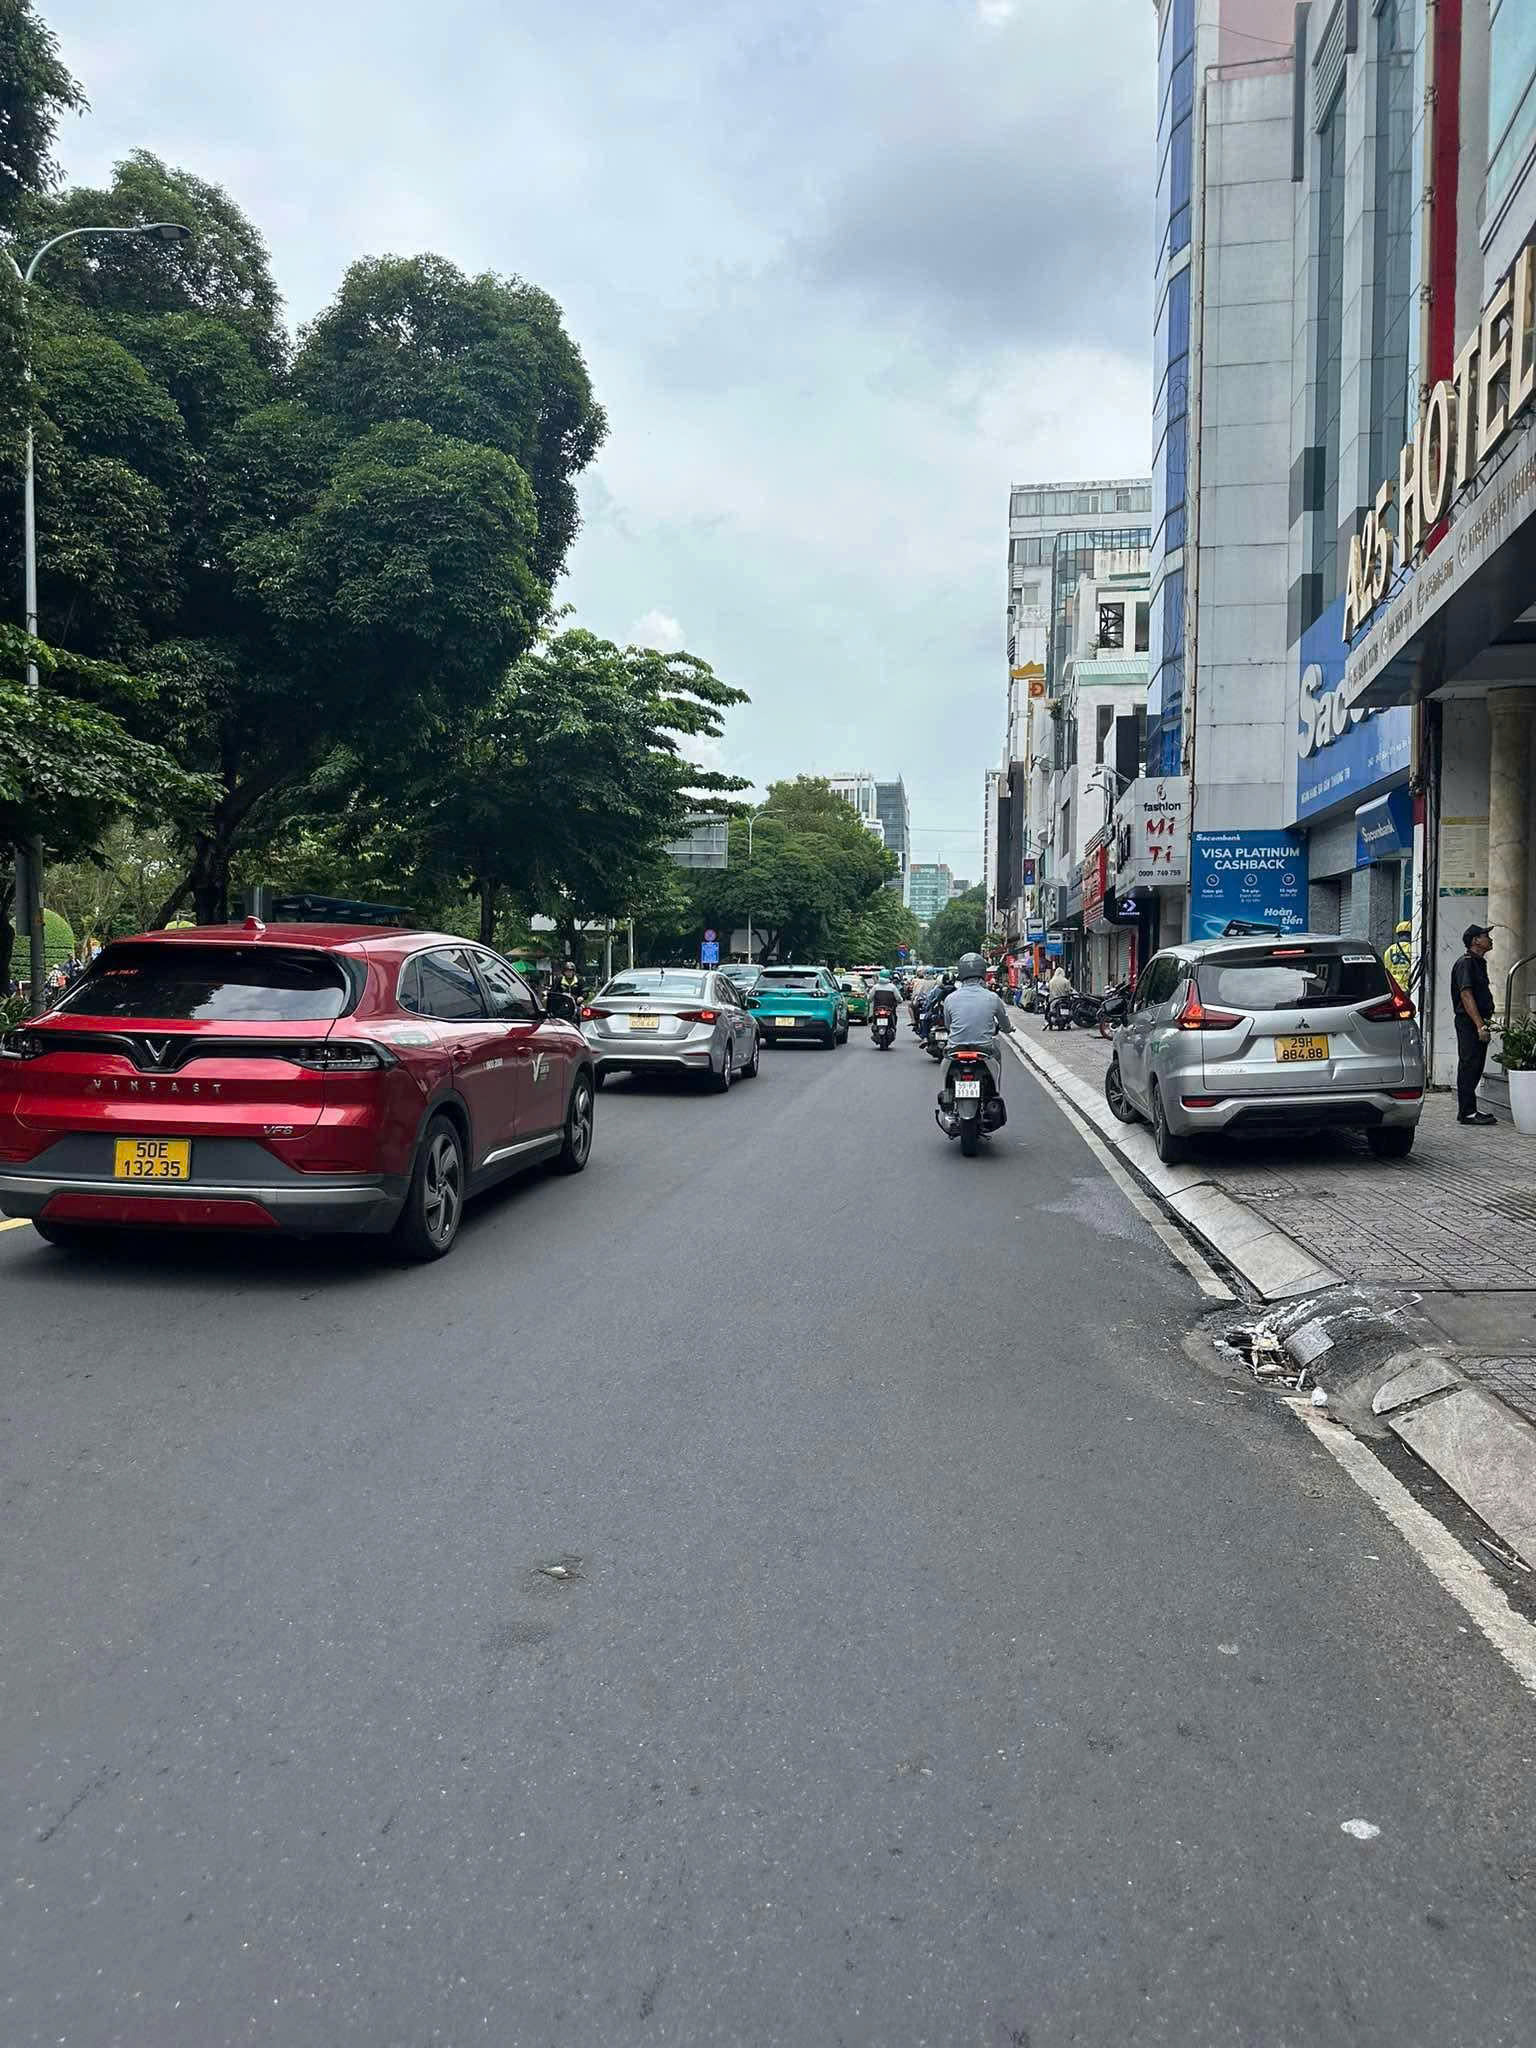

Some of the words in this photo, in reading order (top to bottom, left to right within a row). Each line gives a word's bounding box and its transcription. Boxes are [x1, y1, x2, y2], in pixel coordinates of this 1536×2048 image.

[1342, 479, 1395, 643] A25
[1399, 243, 1536, 568] HOTEL
[1143, 802, 1181, 813] fashion
[1361, 818, 1395, 844] Sacombank
[1195, 834, 1241, 842] Sacombank
[1201, 848, 1232, 858] VISA
[1235, 847, 1300, 858] PLATINUM
[1214, 859, 1286, 870] CASHBACK
[1264, 907, 1293, 917] Hoàn
[1291, 1037, 1313, 1048] 29H
[1282, 1048, 1323, 1060] 884.88
[93, 1078, 223, 1094] VINFAST
[135, 1142, 169, 1159] 50E
[124, 1160, 181, 1177] 132.35
